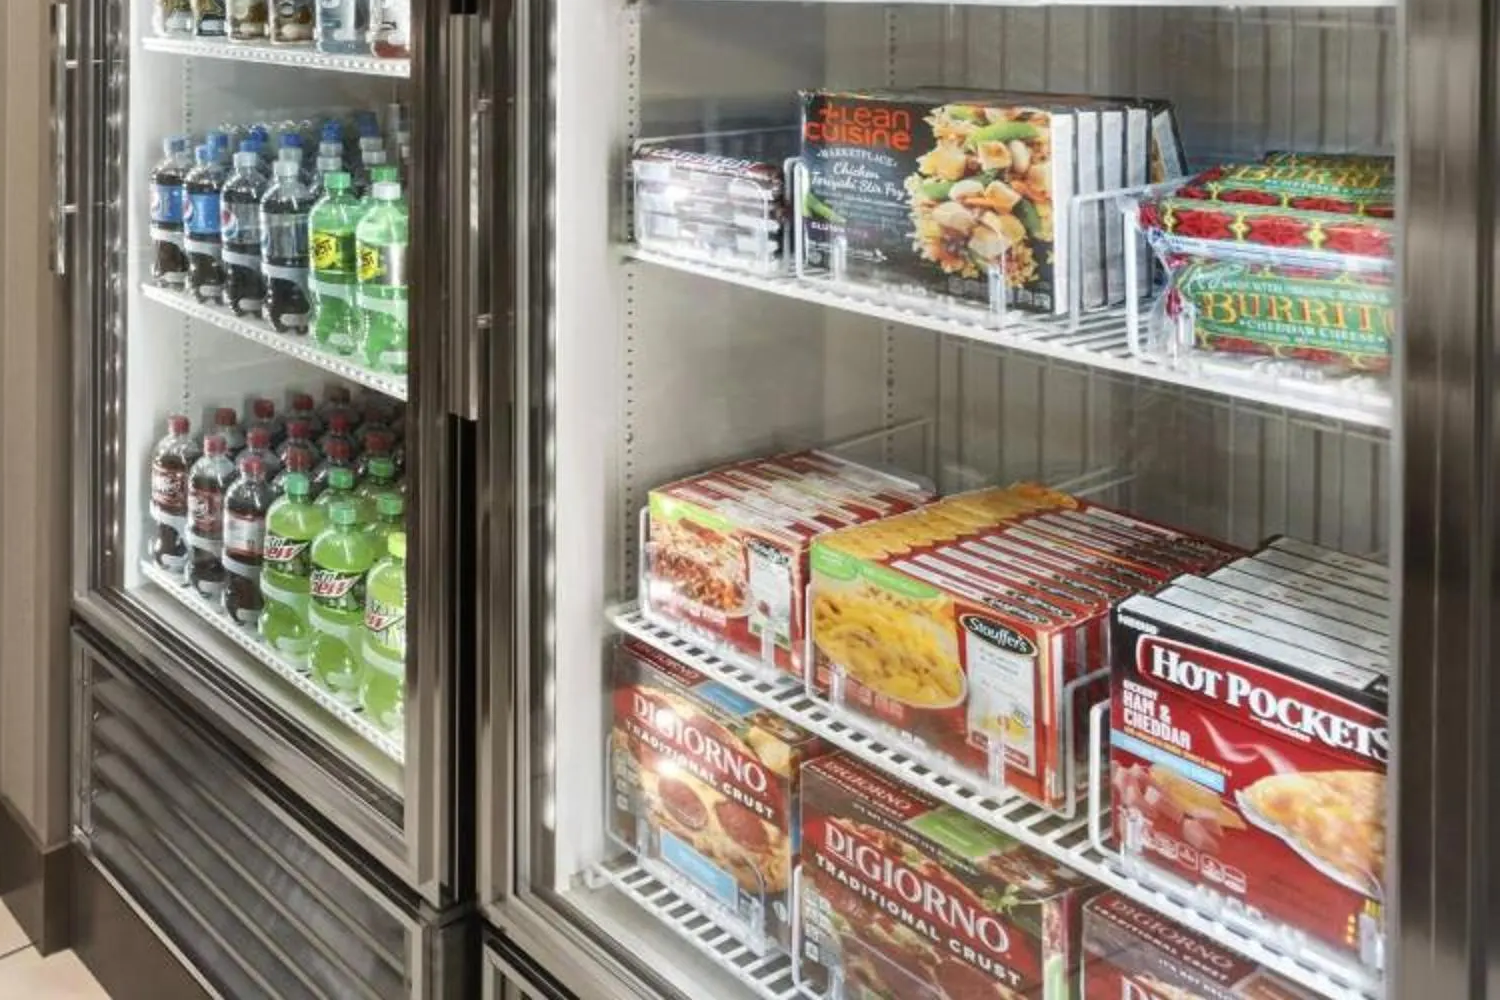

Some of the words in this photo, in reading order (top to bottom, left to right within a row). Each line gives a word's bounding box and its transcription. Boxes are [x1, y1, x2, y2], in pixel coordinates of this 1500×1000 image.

[804, 120, 912, 151] cuisine
[1124, 691, 1156, 718] HAM
[1159, 704, 1172, 725] &
[1124, 708, 1191, 750] CHEDDAR
[1151, 645, 1223, 699] HOT
[1226, 671, 1388, 762] POCKETS
[722, 782, 775, 819] CRUST
[824, 820, 1010, 953] DIGIORNO
[816, 854, 942, 943] TRADITIONAL
[948, 938, 1022, 987] CRUST
[1110, 899, 1235, 970] DIGIORNO
